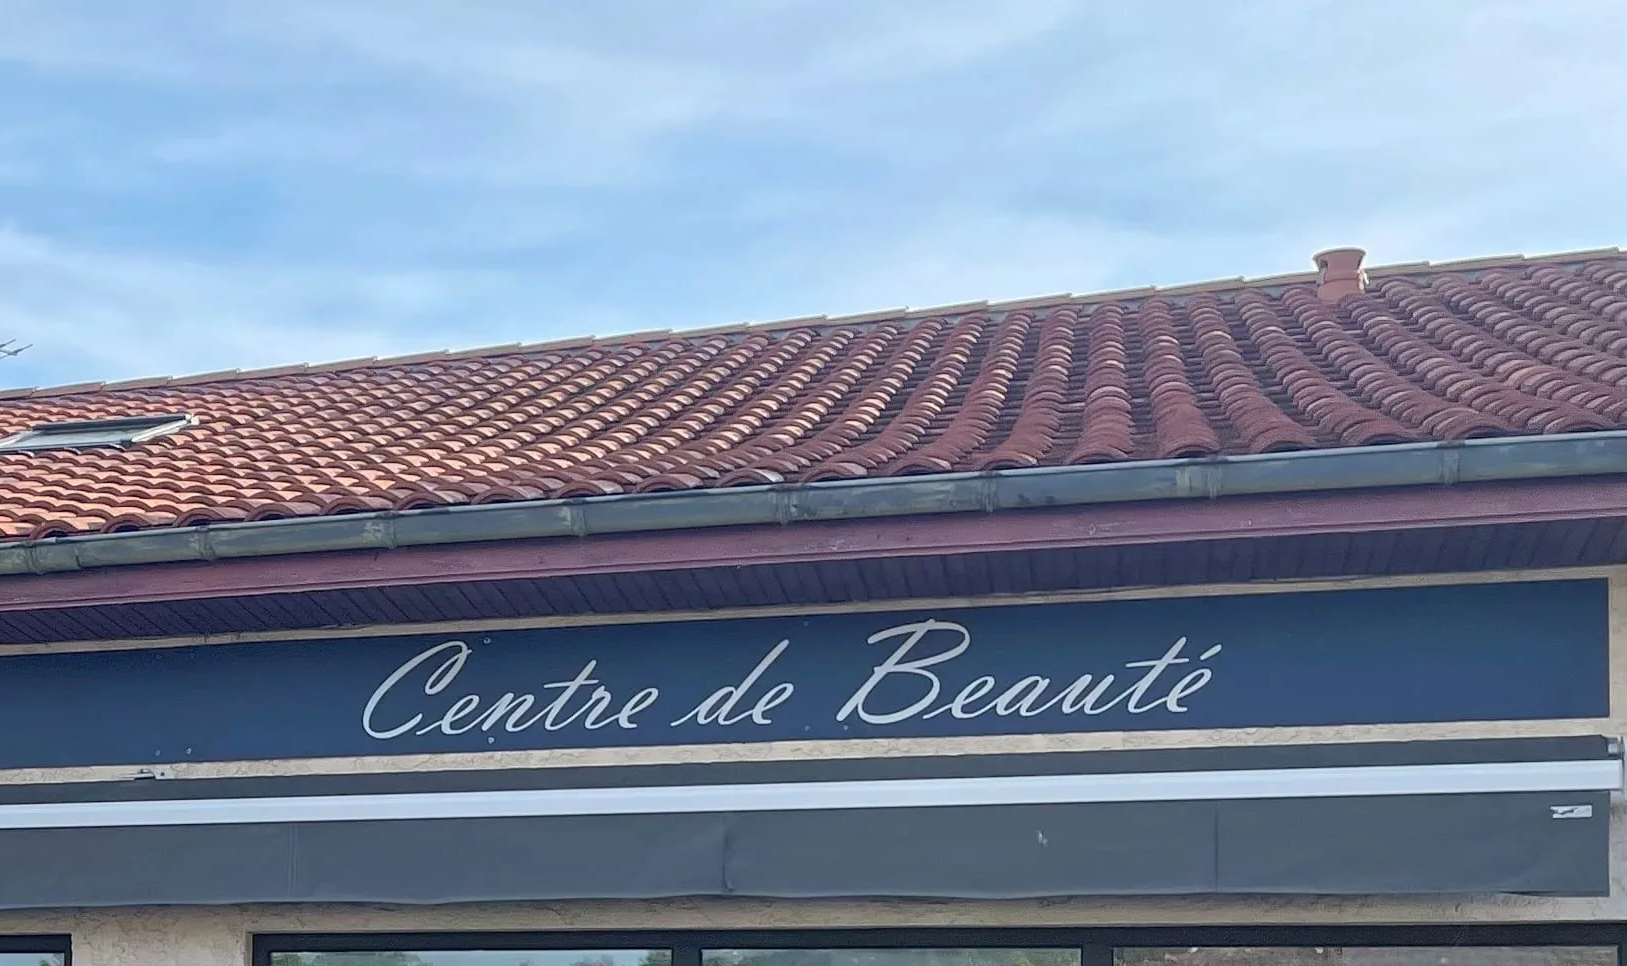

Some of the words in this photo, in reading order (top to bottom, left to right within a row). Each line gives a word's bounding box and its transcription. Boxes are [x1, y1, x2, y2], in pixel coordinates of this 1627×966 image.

[360, 640, 660, 740] Centre
[671, 638, 794, 727] de
[836, 618, 1222, 726] Beauté
